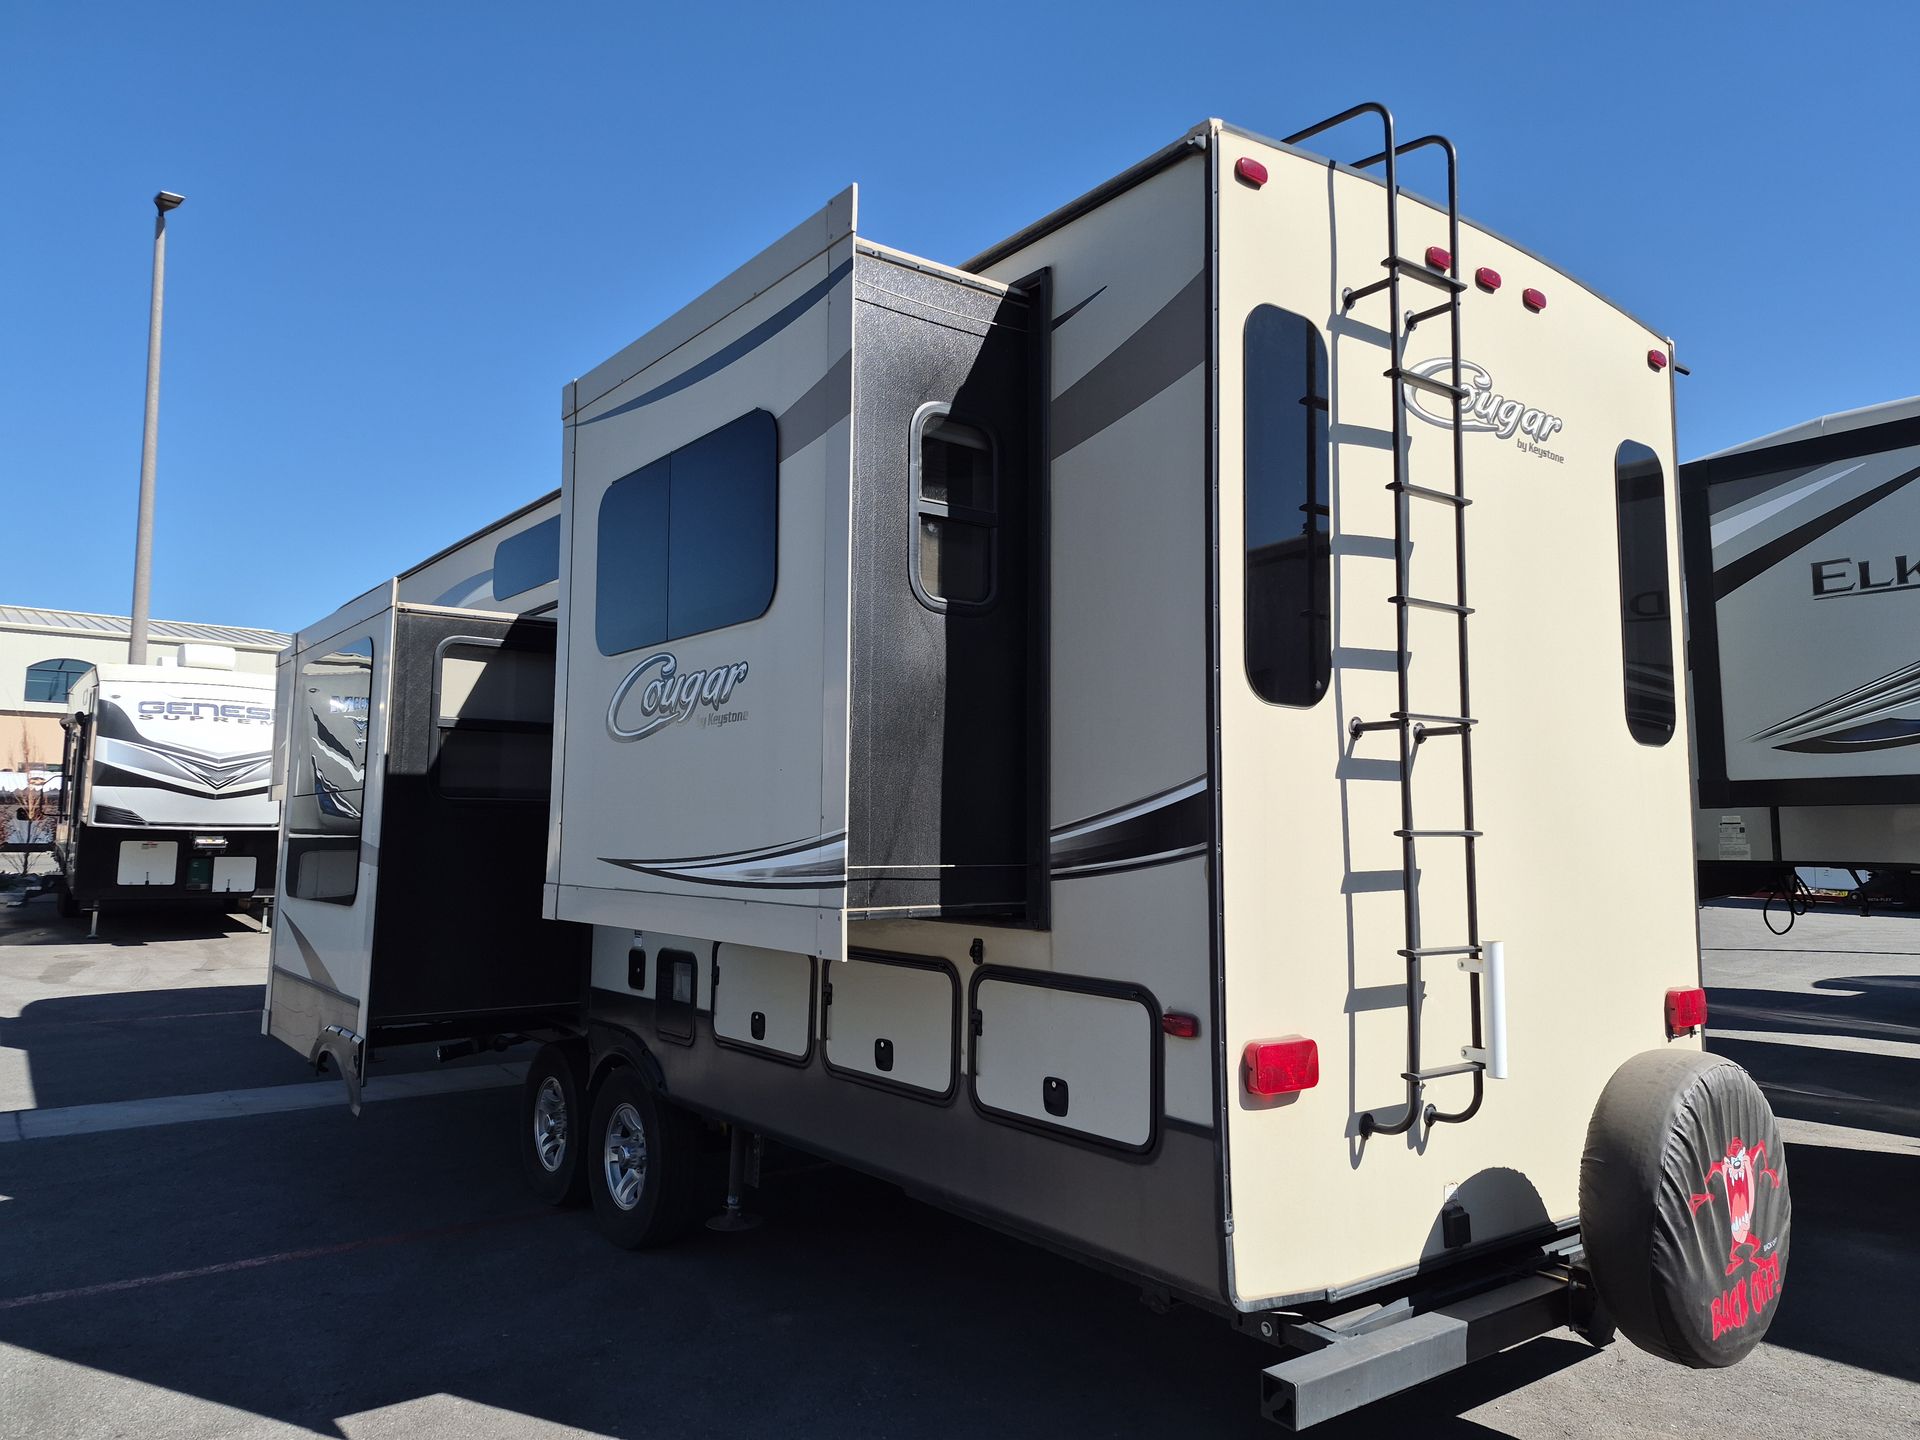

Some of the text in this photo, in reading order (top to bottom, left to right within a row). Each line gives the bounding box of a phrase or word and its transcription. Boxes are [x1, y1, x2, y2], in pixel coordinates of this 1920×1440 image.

[1402, 357, 1563, 444] Cougar
[1517, 438, 1565, 464] by Keystone
[1810, 555, 1920, 595] ELK
[605, 652, 749, 743] Cougar
[707, 710, 749, 728] Keystone
[1711, 1276, 1749, 1341] BACK
